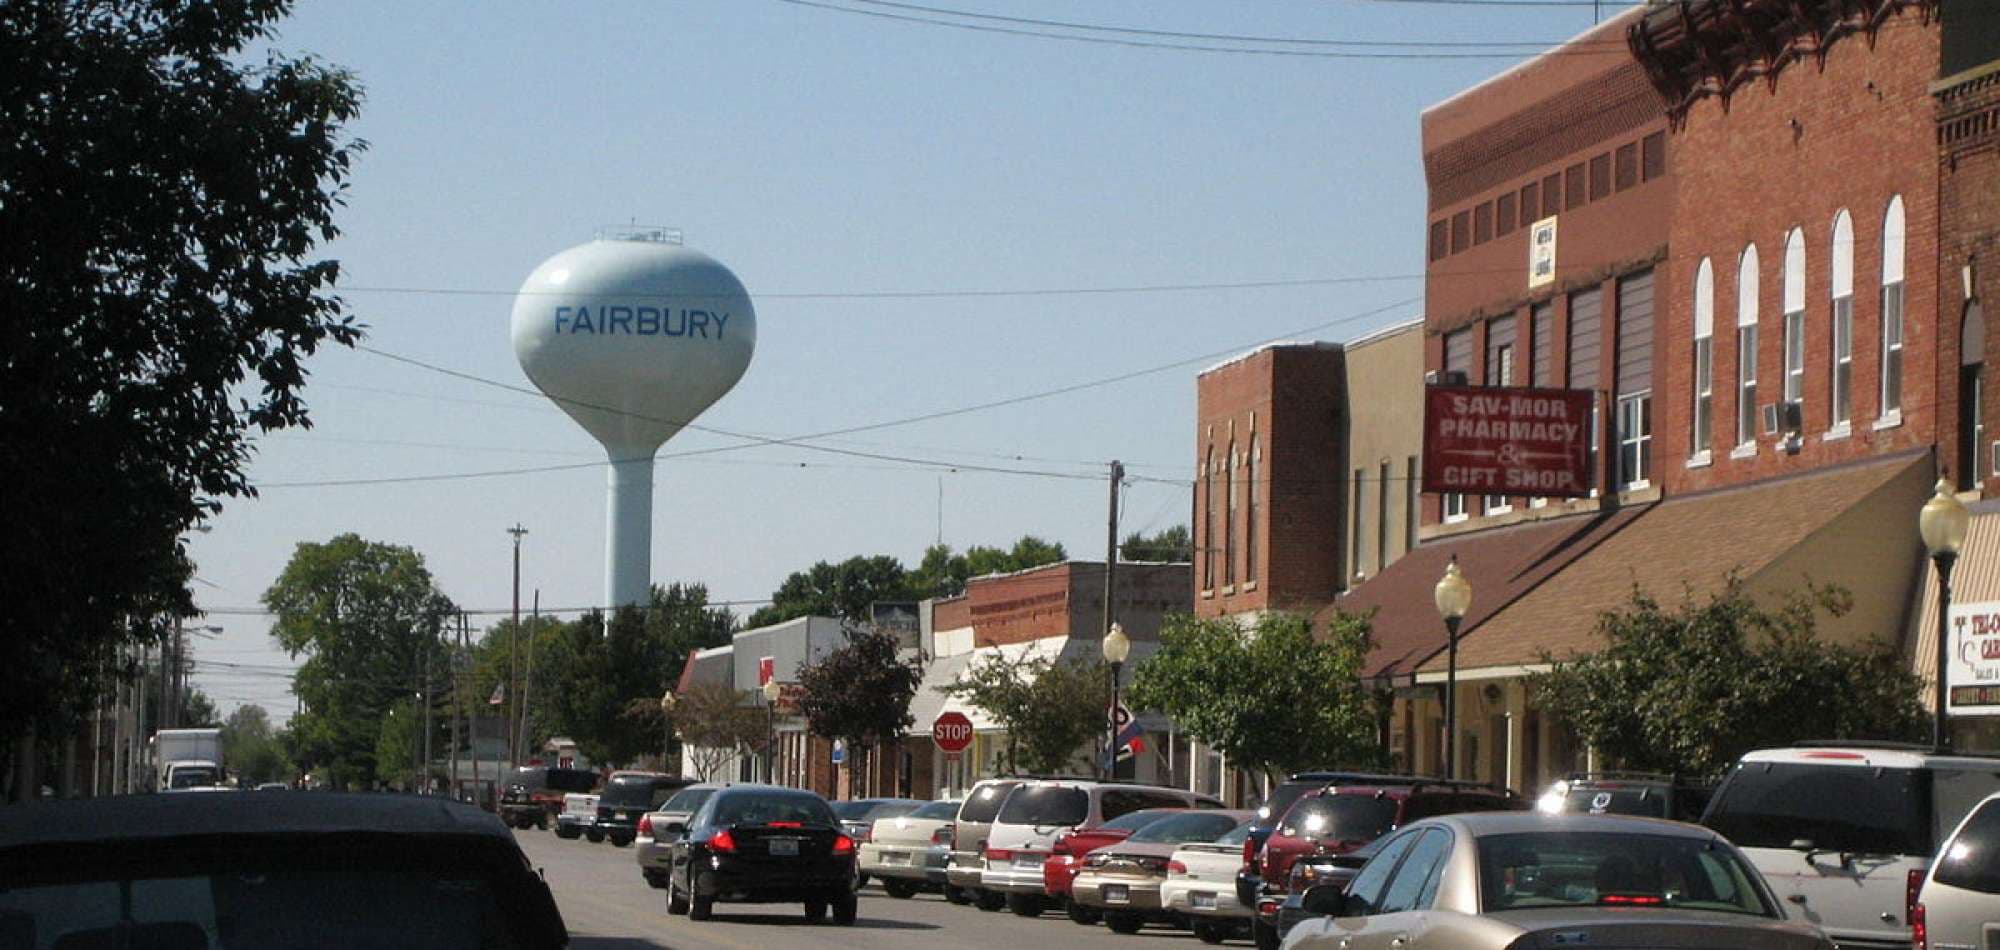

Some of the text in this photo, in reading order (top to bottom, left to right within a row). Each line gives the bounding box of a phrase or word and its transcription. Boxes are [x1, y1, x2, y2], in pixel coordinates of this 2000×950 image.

[554, 306, 729, 340] FAIRBURY
[1453, 396, 1567, 418] SAV-MOR
[1440, 419, 1578, 442] PHARMACY
[1496, 444, 1521, 465] &
[1443, 466, 1574, 489] GIFT SHOP
[935, 724, 971, 740] STOP
